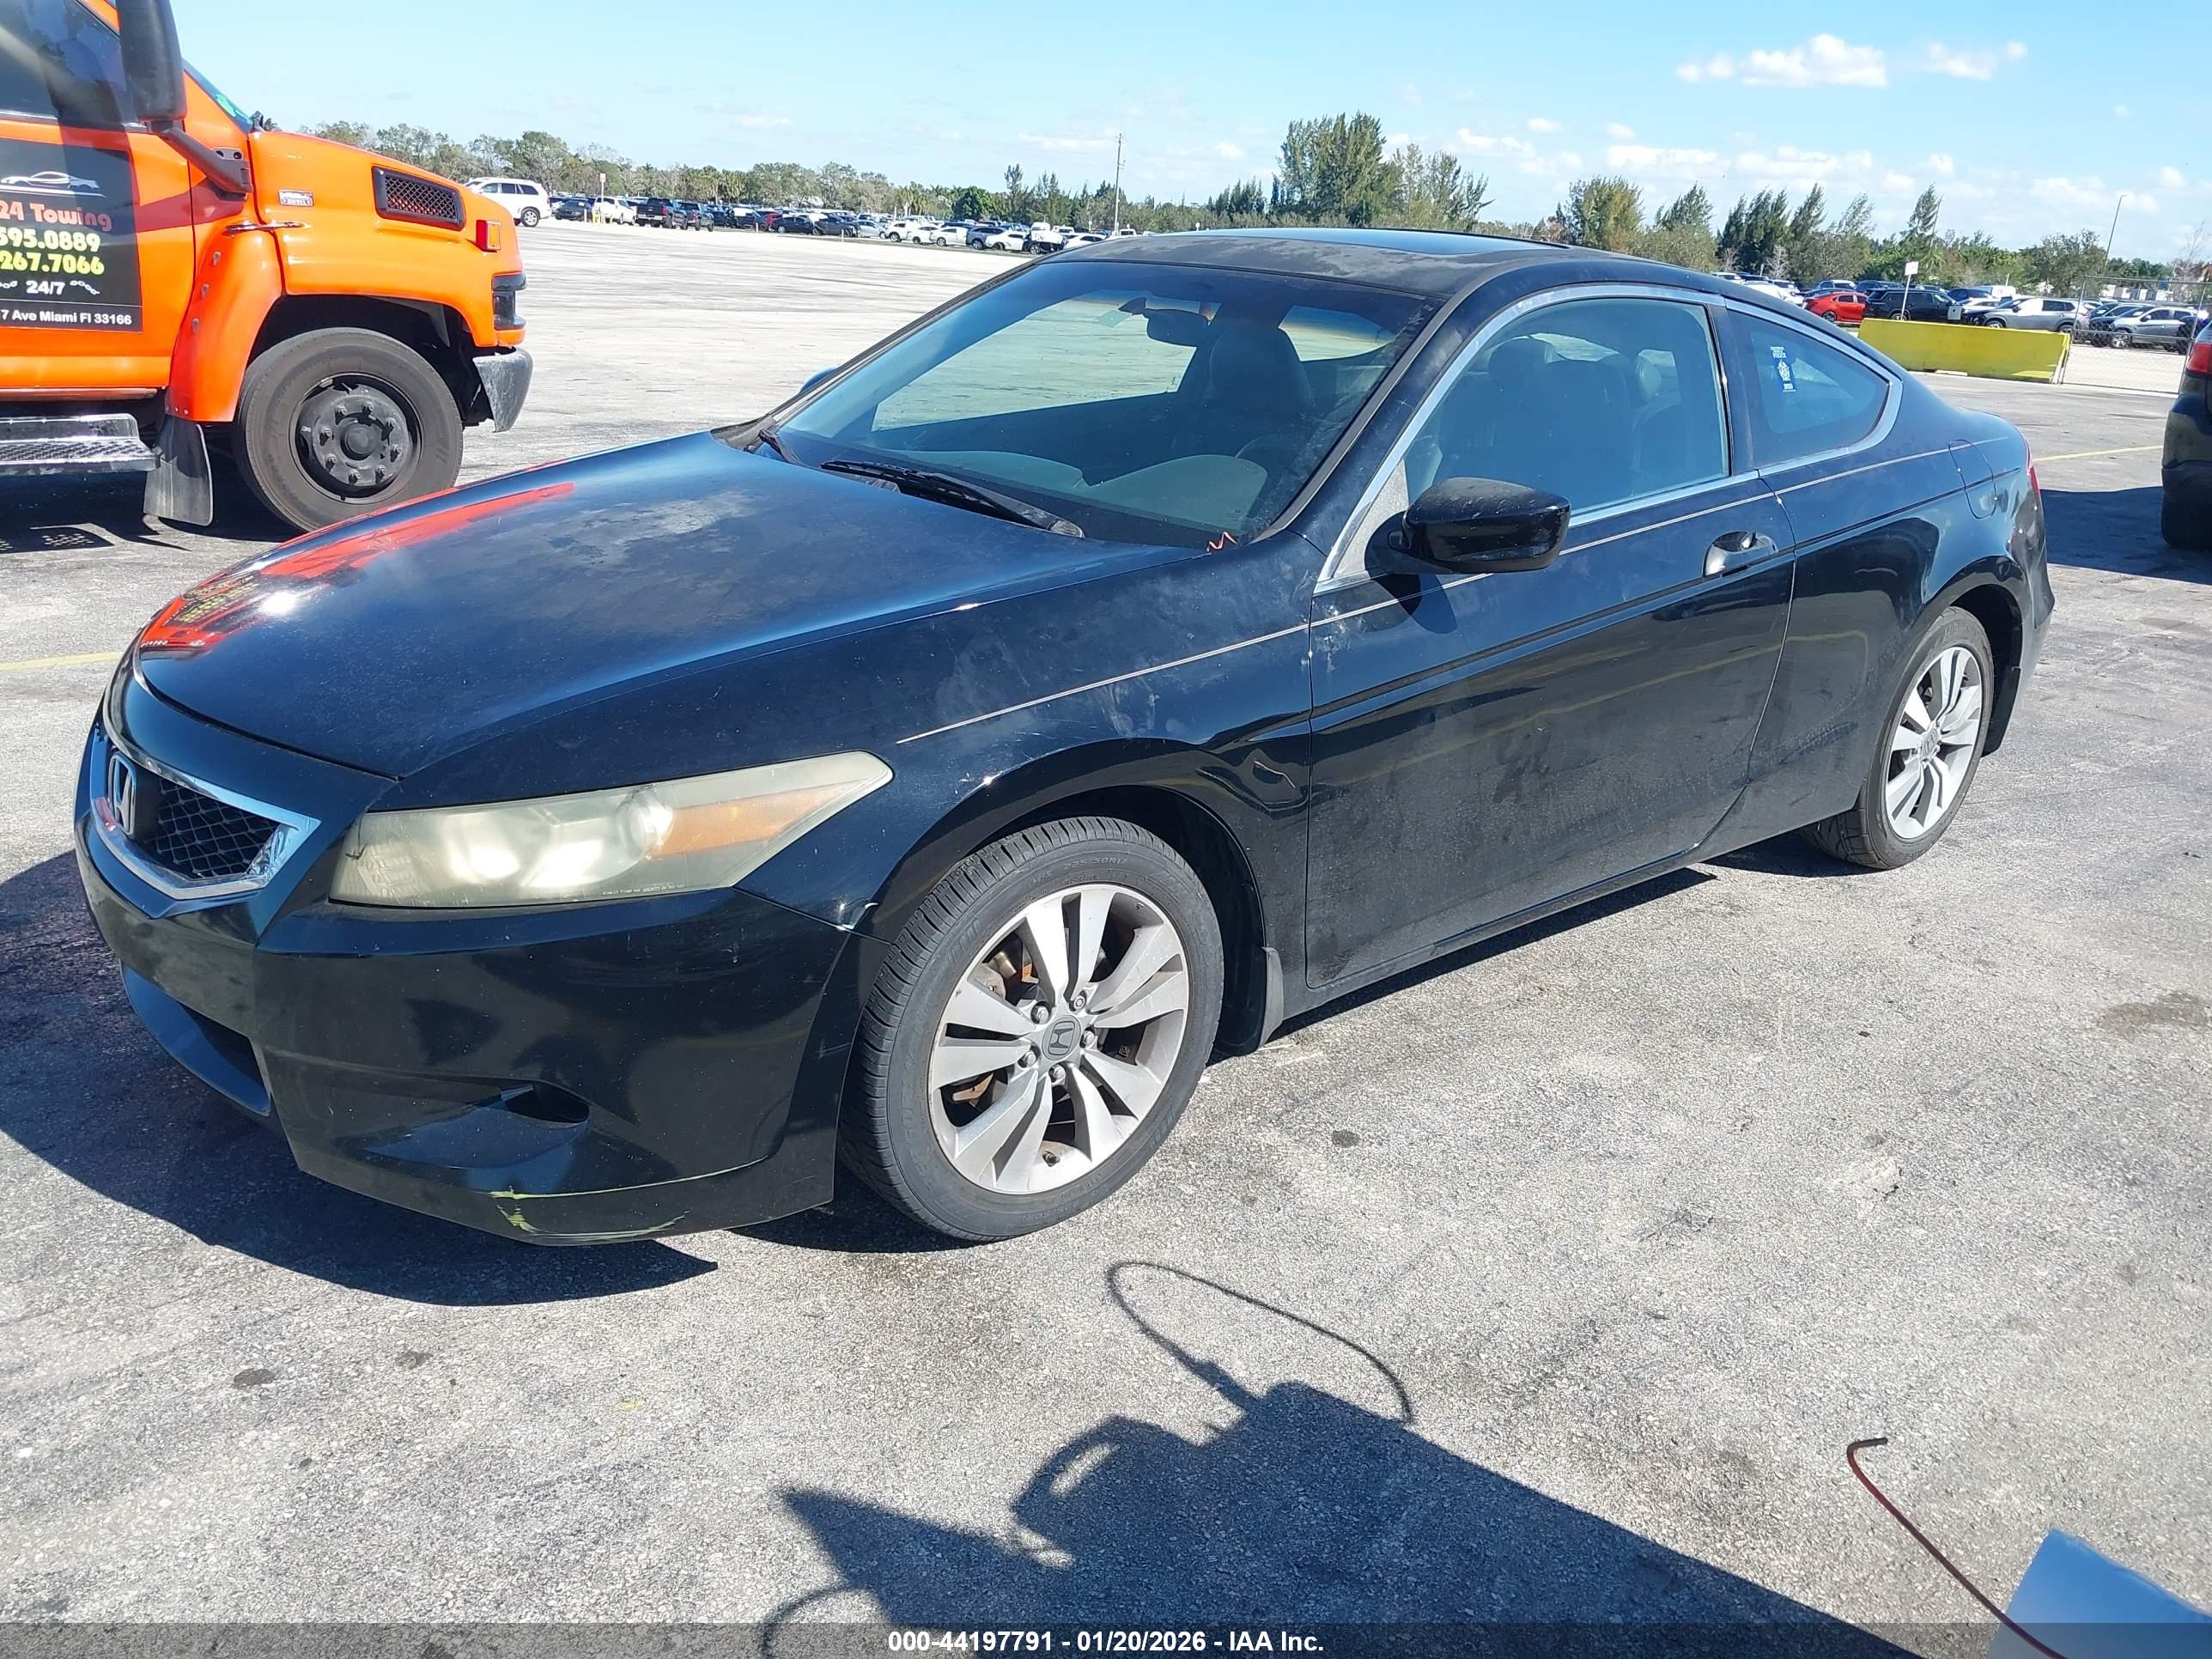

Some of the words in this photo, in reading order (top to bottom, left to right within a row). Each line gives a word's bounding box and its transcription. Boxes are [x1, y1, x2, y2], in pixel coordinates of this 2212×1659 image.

[29, 203, 112, 232] Towing
[26, 280, 65, 295] 24/7
[12, 310, 37, 321] Ave
[40, 311, 77, 323] Miami
[94, 313, 132, 325] 33166
